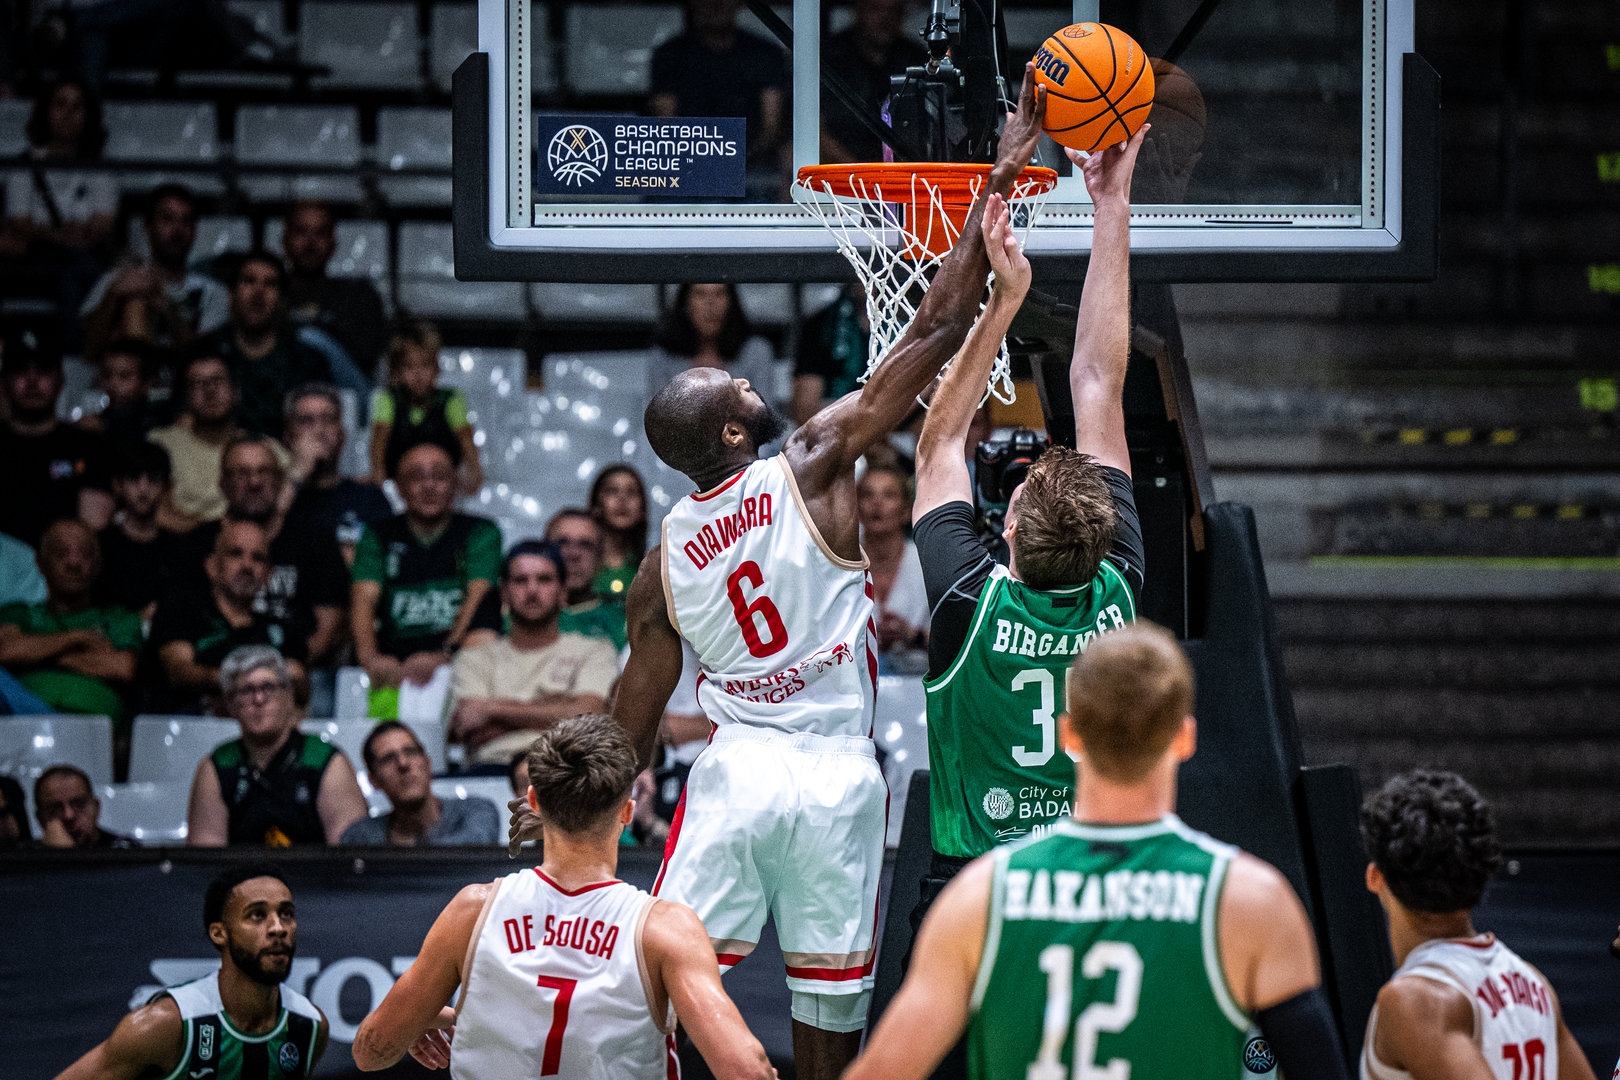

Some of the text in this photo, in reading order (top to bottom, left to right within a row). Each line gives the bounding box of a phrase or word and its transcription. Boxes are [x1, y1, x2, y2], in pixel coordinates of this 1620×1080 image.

[614, 124, 724, 139] BASKETBALL
[614, 140, 737, 156] CHAMPIONS
[614, 157, 681, 171] LEAGUE
[615, 176, 680, 188] SEASON X
[683, 492, 773, 571] DIAWARA
[726, 560, 789, 659] 6
[992, 603, 1128, 658] BIRGANER
[1019, 785, 1069, 800] City of
[1003, 868, 1205, 925] HAKANSON
[503, 914, 620, 961] DE SOUSA
[536, 974, 578, 1077] 7
[1026, 940, 1145, 1080] 12
